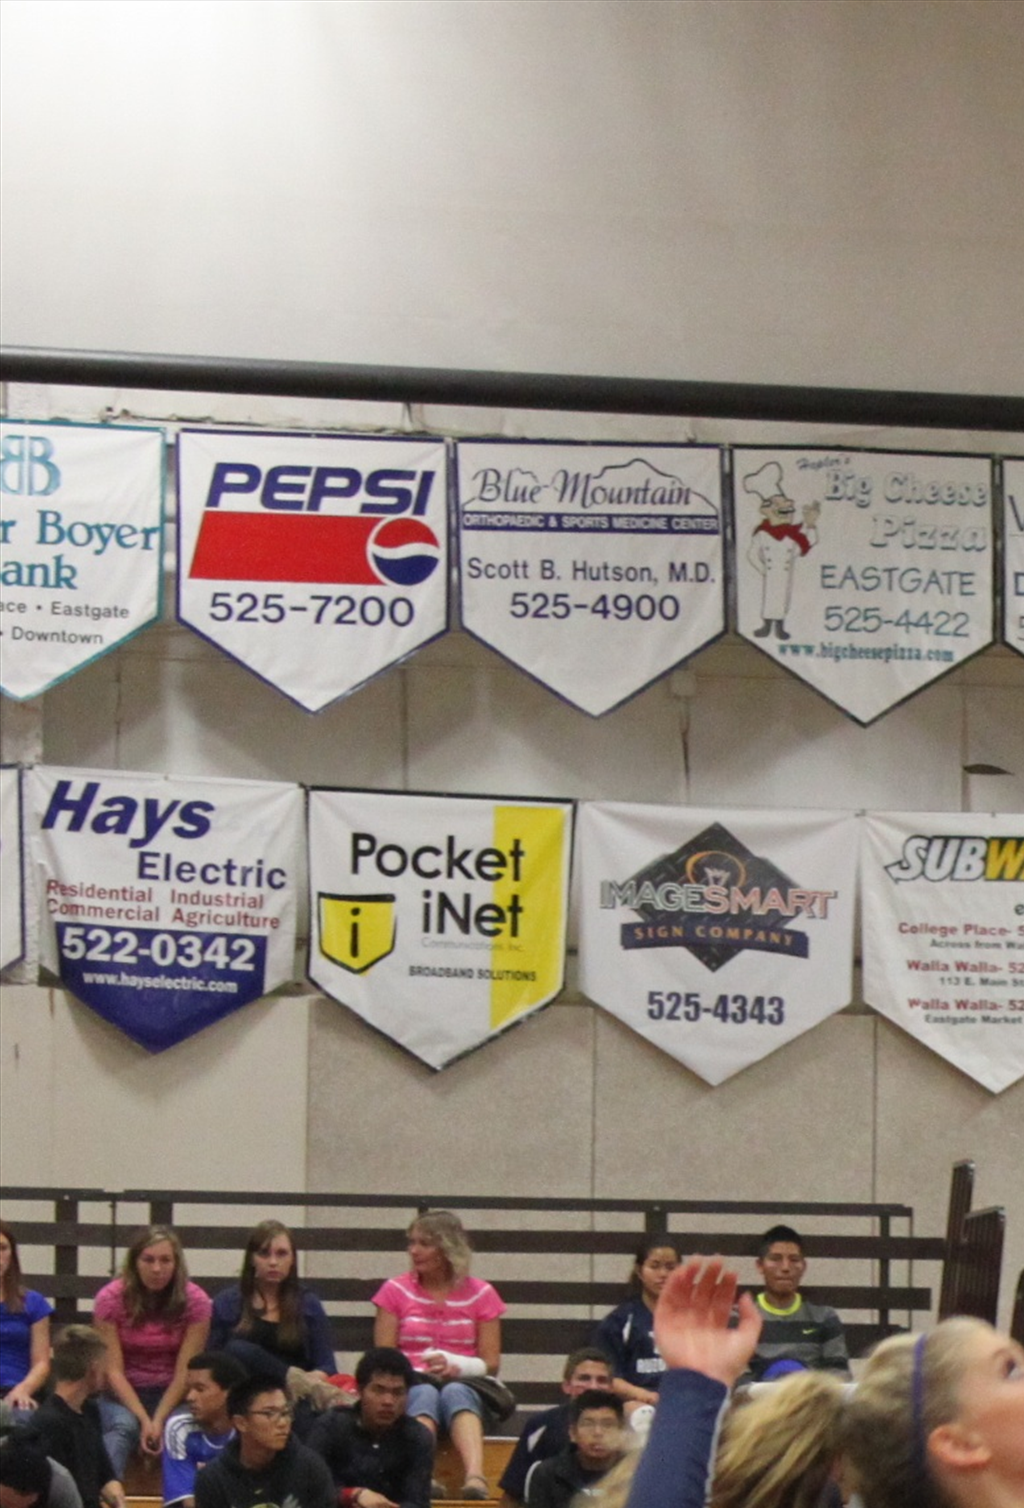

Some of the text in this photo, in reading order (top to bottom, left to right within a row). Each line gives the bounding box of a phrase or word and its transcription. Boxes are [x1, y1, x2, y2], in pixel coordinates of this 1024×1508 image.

[205, 462, 436, 516] PEPSI
[472, 468, 691, 509] Blue Mountain
[37, 509, 160, 556] Boyer
[463, 513, 545, 528] ORTHOPAEDIC
[562, 516, 608, 530] SPORTS
[612, 516, 668, 531] MEDICINE
[671, 517, 718, 531] CENTER
[467, 557, 716, 586] Scott B. Hutson, M.D.
[820, 564, 976, 596] EASTGATE
[51, 601, 130, 620] Eastgate
[209, 592, 415, 627] 525-7200
[510, 592, 680, 621] 525-4900
[824, 606, 970, 637] 525-4422
[11, 625, 104, 645] Downtown
[40, 779, 216, 850] Hays
[137, 850, 288, 890] Electric
[351, 832, 525, 882] Pocket
[46, 878, 265, 911] Residential Industrial
[600, 879, 838, 920] IMAGESMART
[46, 898, 281, 930] Commercial Agriculture
[422, 889, 524, 938] iNet
[898, 921, 958, 938] College
[61, 926, 256, 972] 522-0342
[633, 925, 794, 946] SIGN COMPANY
[82, 970, 239, 994] www.hayselectric.com
[408, 965, 537, 982] BROADBAND SOLUTIONS
[907, 959, 949, 973] Walla
[647, 990, 785, 1026] 525-4343
[907, 997, 949, 1011] Walla
